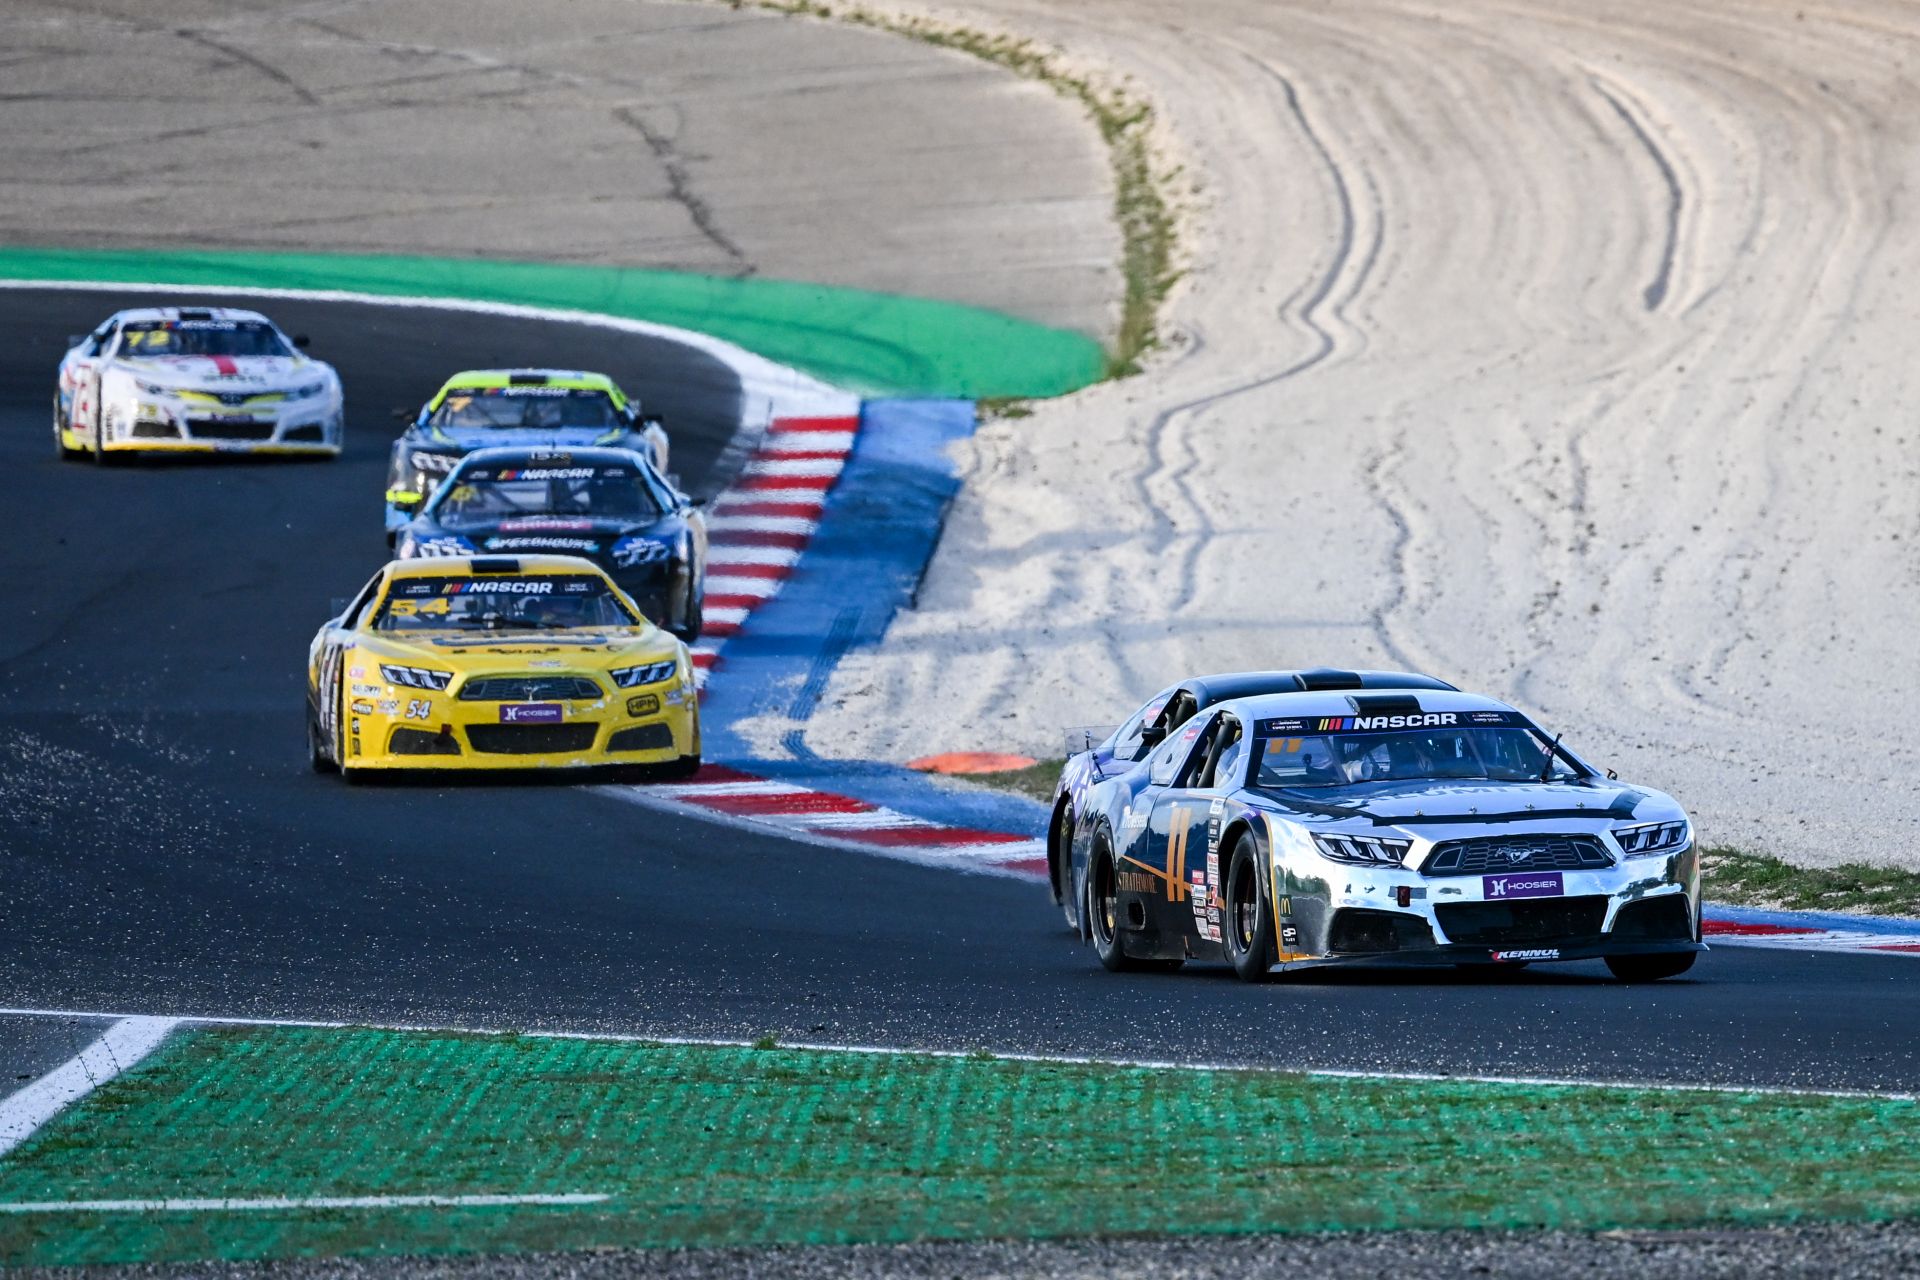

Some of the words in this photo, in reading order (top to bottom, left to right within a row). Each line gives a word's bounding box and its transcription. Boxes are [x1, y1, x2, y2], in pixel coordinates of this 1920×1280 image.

[520, 468, 595, 480] NASCAR
[469, 582, 553, 594] NASCAR
[390, 598, 450, 616] 54
[405, 700, 432, 719] 54
[1353, 713, 1457, 730] NASCAR
[1507, 881, 1558, 891] HOOSIER
[1497, 949, 1560, 959] KENNOL
